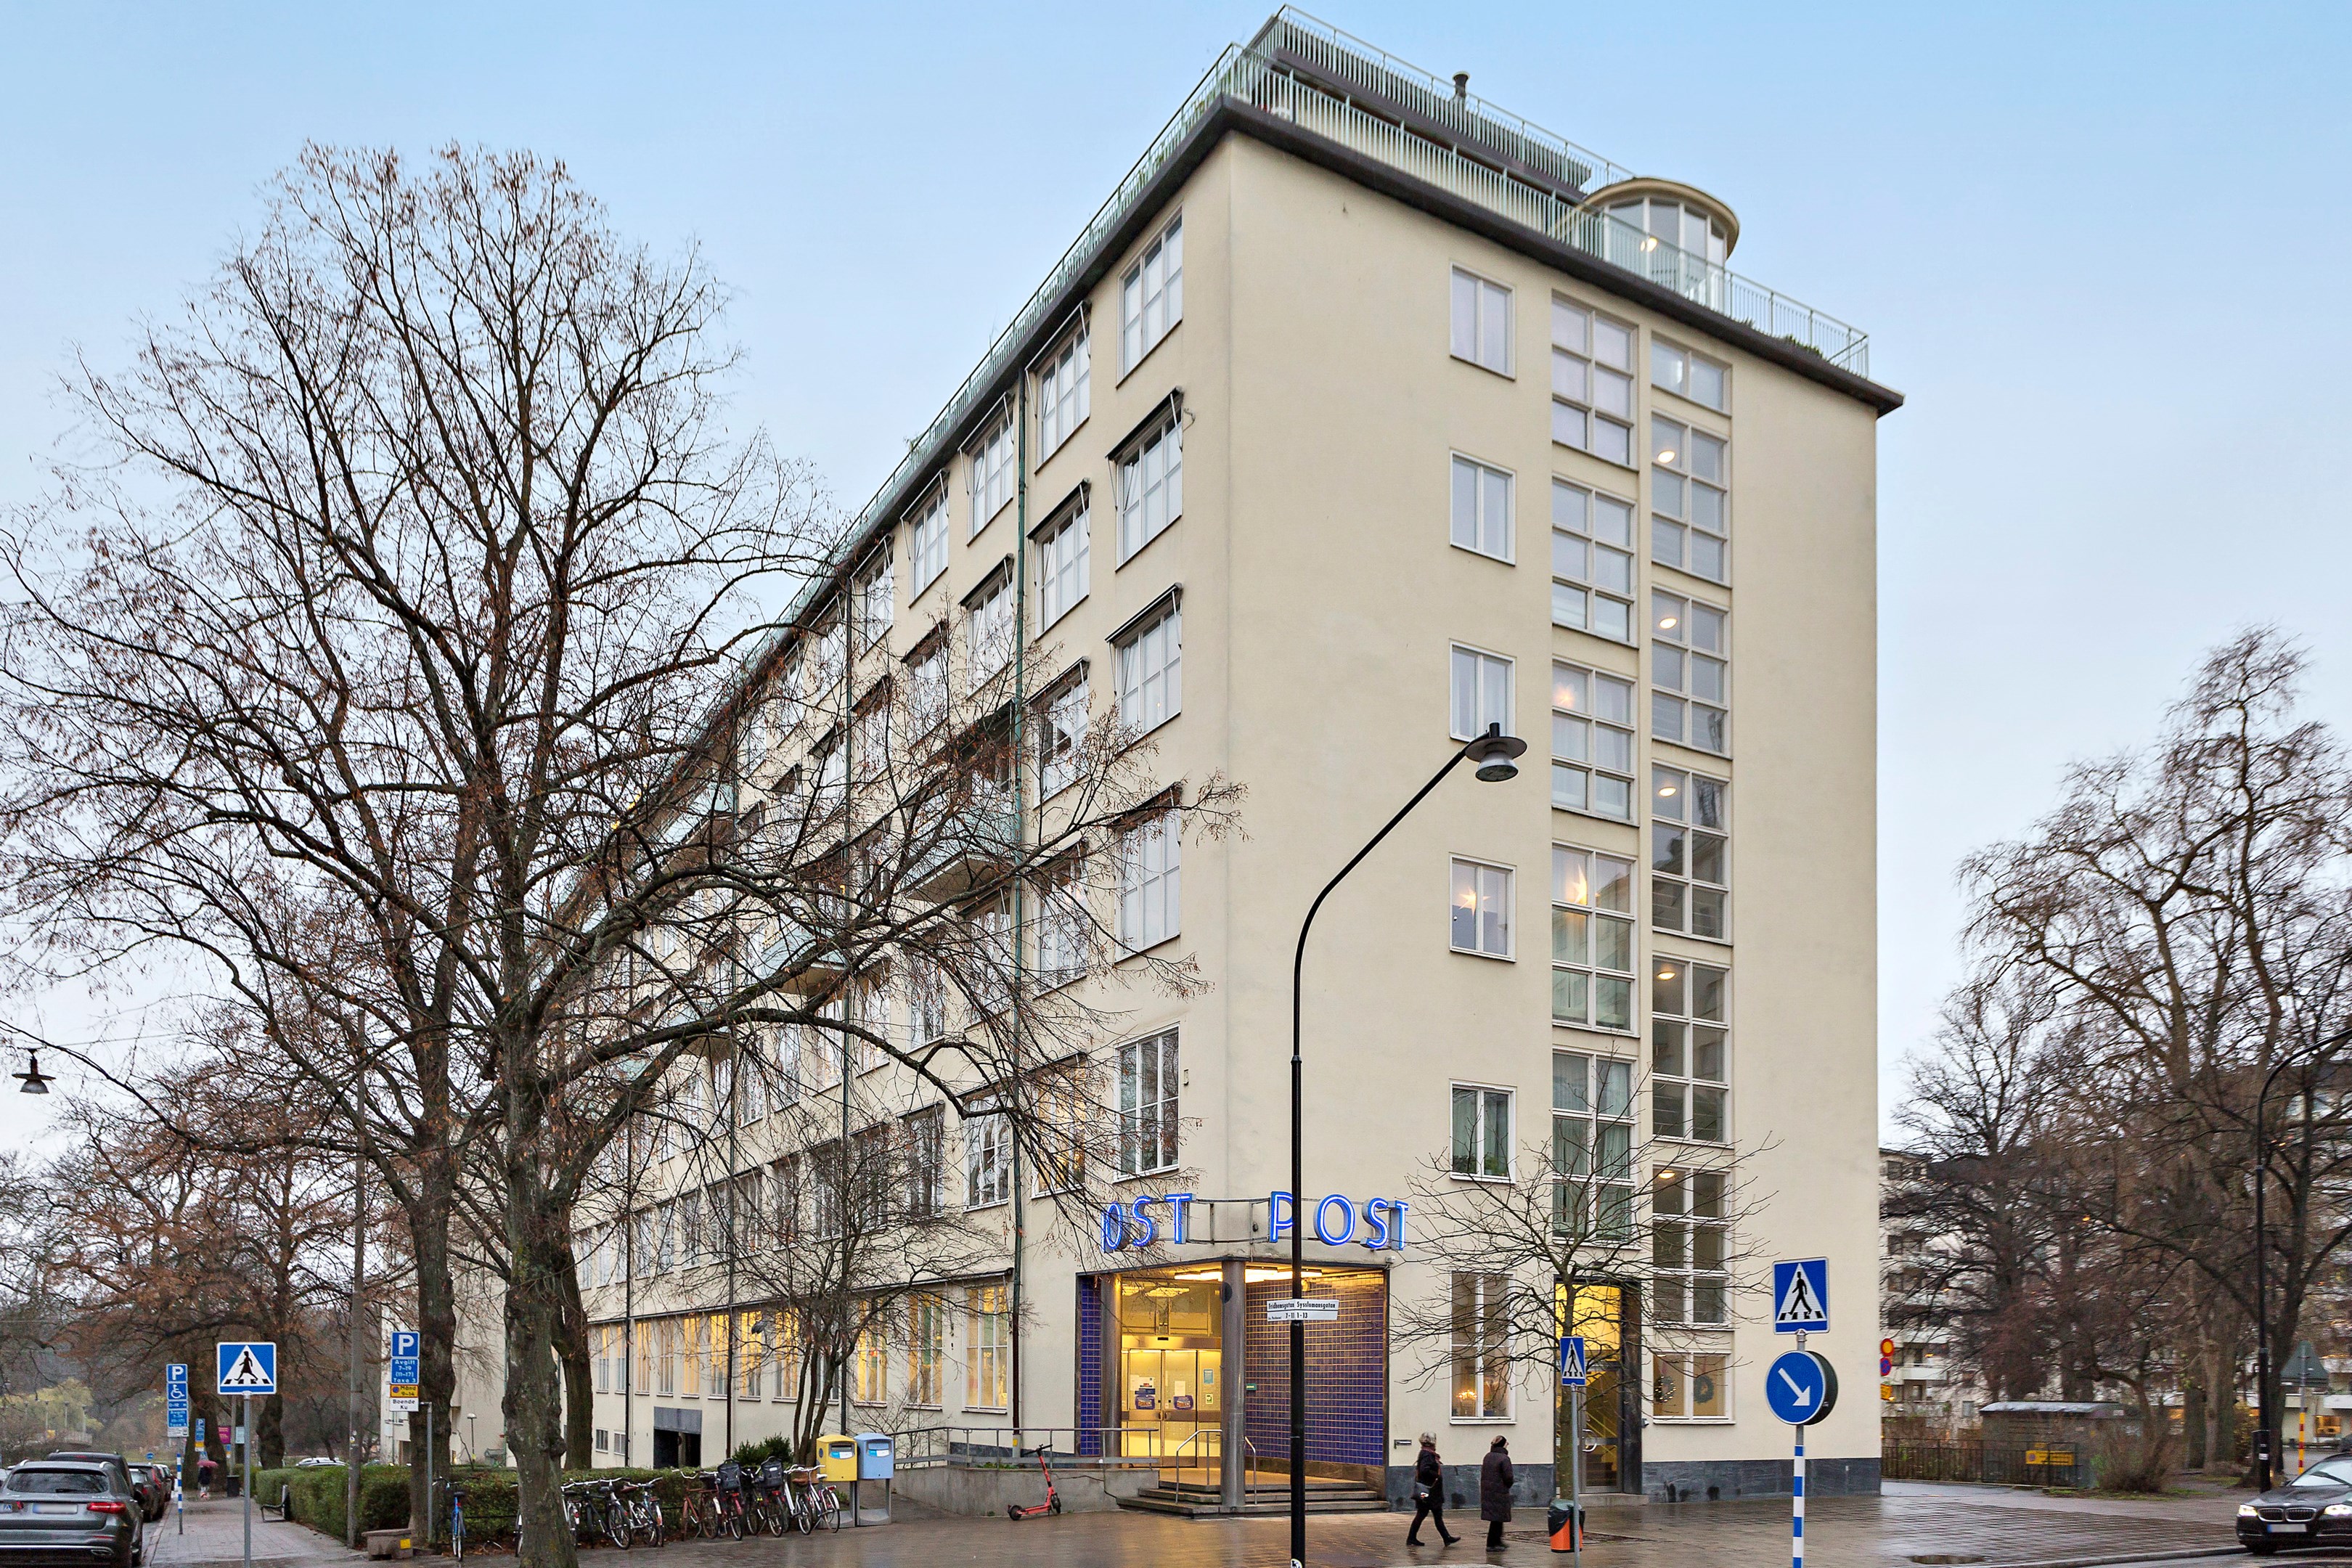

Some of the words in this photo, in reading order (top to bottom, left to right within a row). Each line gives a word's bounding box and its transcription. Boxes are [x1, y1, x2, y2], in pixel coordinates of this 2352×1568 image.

[1270, 1191, 1409, 1251] POST
[1297, 1301, 1336, 1310] Sysslomansgatan
[399, 1334, 415, 1355] P
[172, 1365, 184, 1381] P
